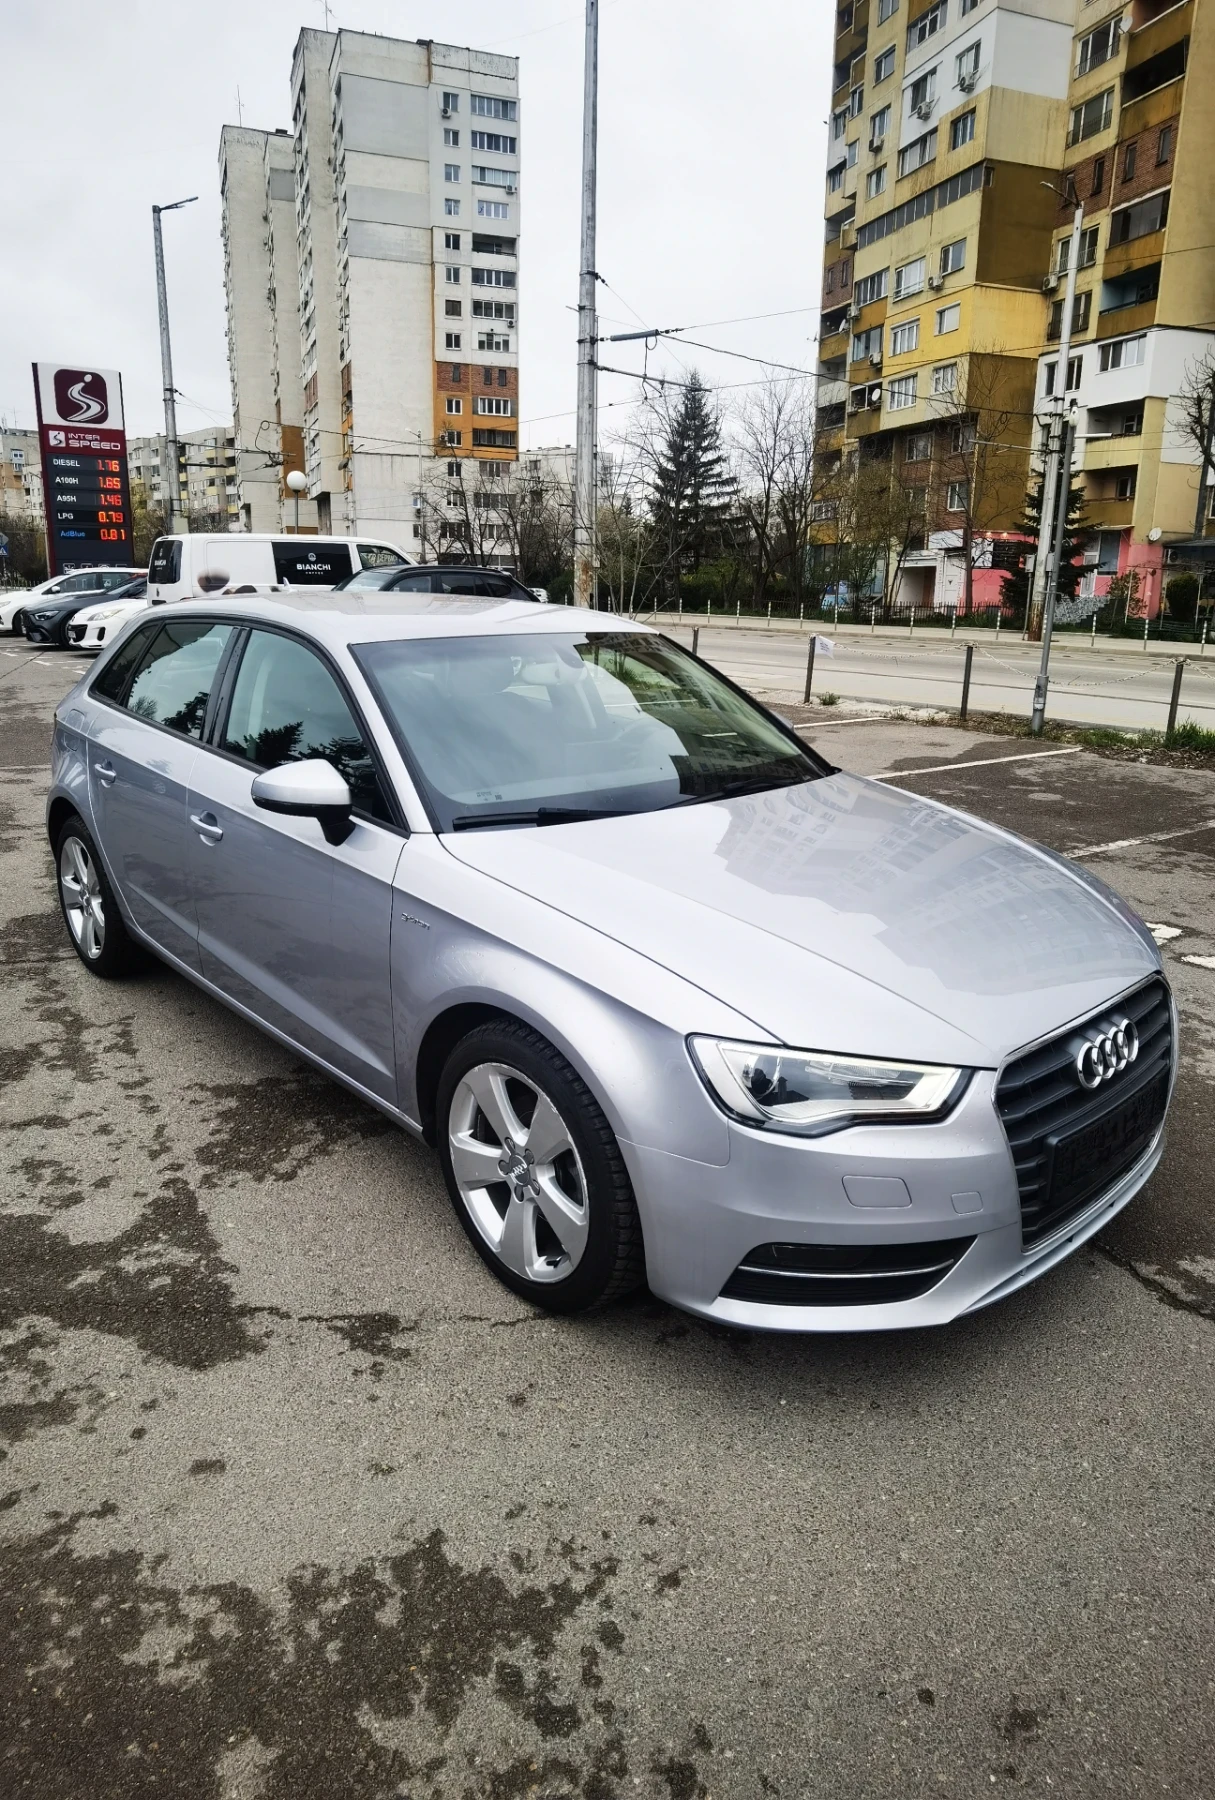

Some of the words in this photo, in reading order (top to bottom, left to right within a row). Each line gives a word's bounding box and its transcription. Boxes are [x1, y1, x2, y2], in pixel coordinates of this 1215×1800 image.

[69, 440, 120, 450] SPEED
[98, 459, 120, 471] 1.76
[55, 476, 79, 484] A100H
[99, 477, 121, 489] 1.65
[100, 494, 122, 505] 1.46
[98, 511, 123, 522] 0.79
[100, 528, 125, 541] 0.81
